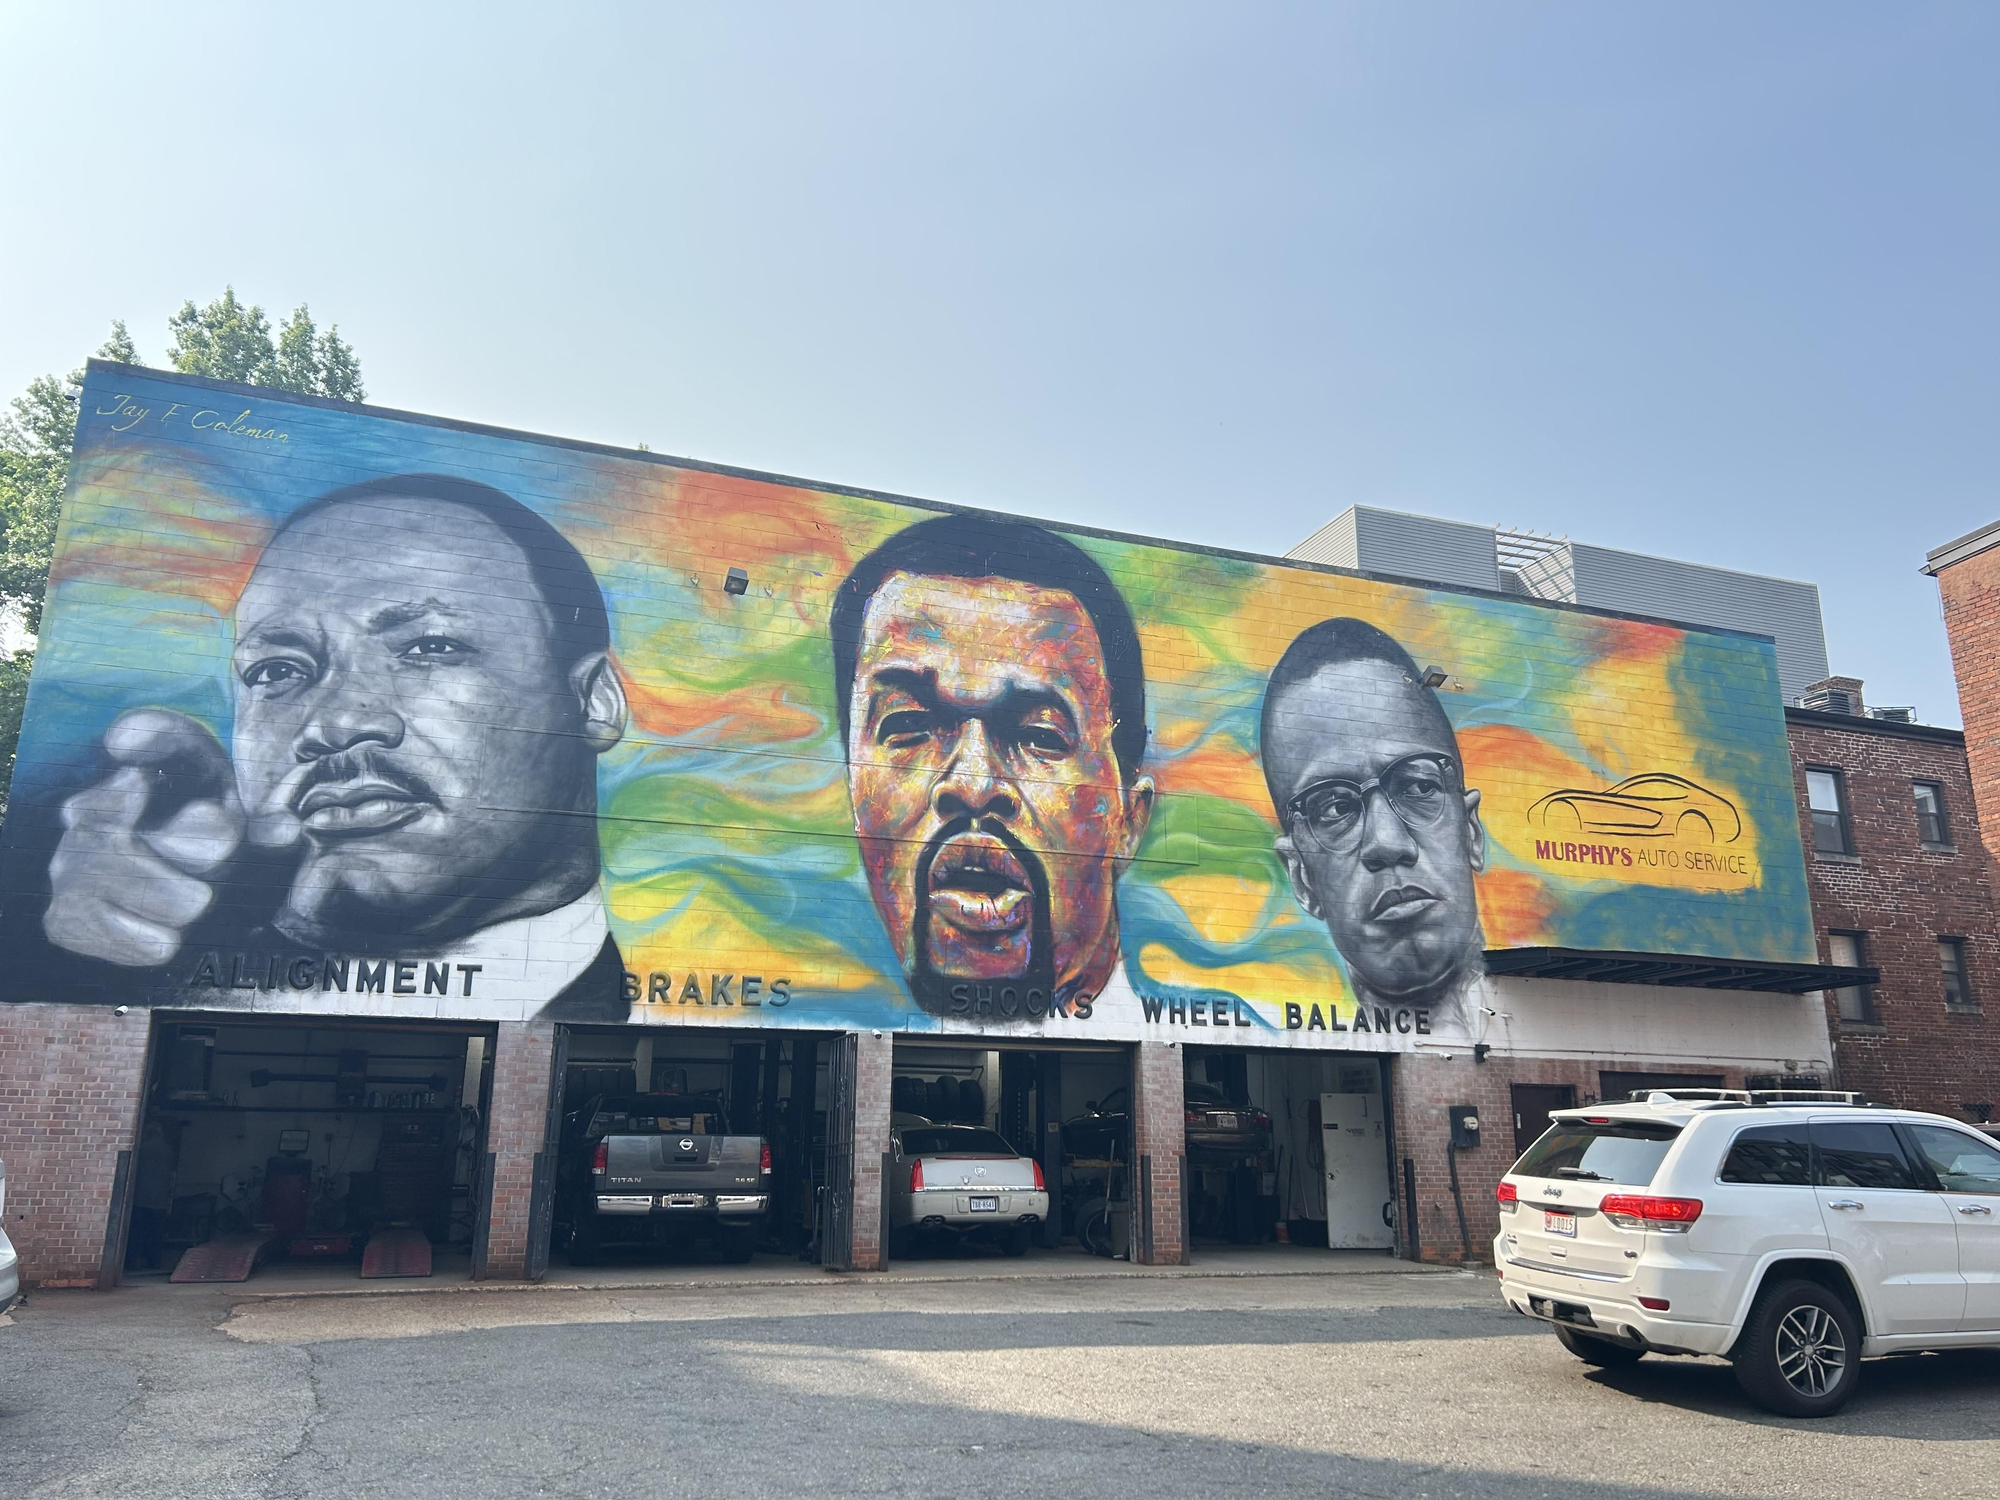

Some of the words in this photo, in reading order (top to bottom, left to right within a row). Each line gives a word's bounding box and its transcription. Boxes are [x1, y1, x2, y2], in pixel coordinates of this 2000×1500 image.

[97, 394, 150, 431] Jay
[161, 403, 189, 422] F
[191, 409, 289, 444] Coleman
[1535, 839, 1633, 867] MURPHY'S
[1638, 848, 1680, 868] AUTO
[1684, 851, 1748, 875] SERVICE
[190, 952, 483, 997] ALIGNMENT
[619, 970, 792, 1007] BRAKES
[950, 983, 1094, 1020] SHOCKS
[1141, 994, 1252, 1028] WHEEL
[1285, 1001, 1431, 1035] BALANCE
[1543, 1185, 1562, 1198] Jeep
